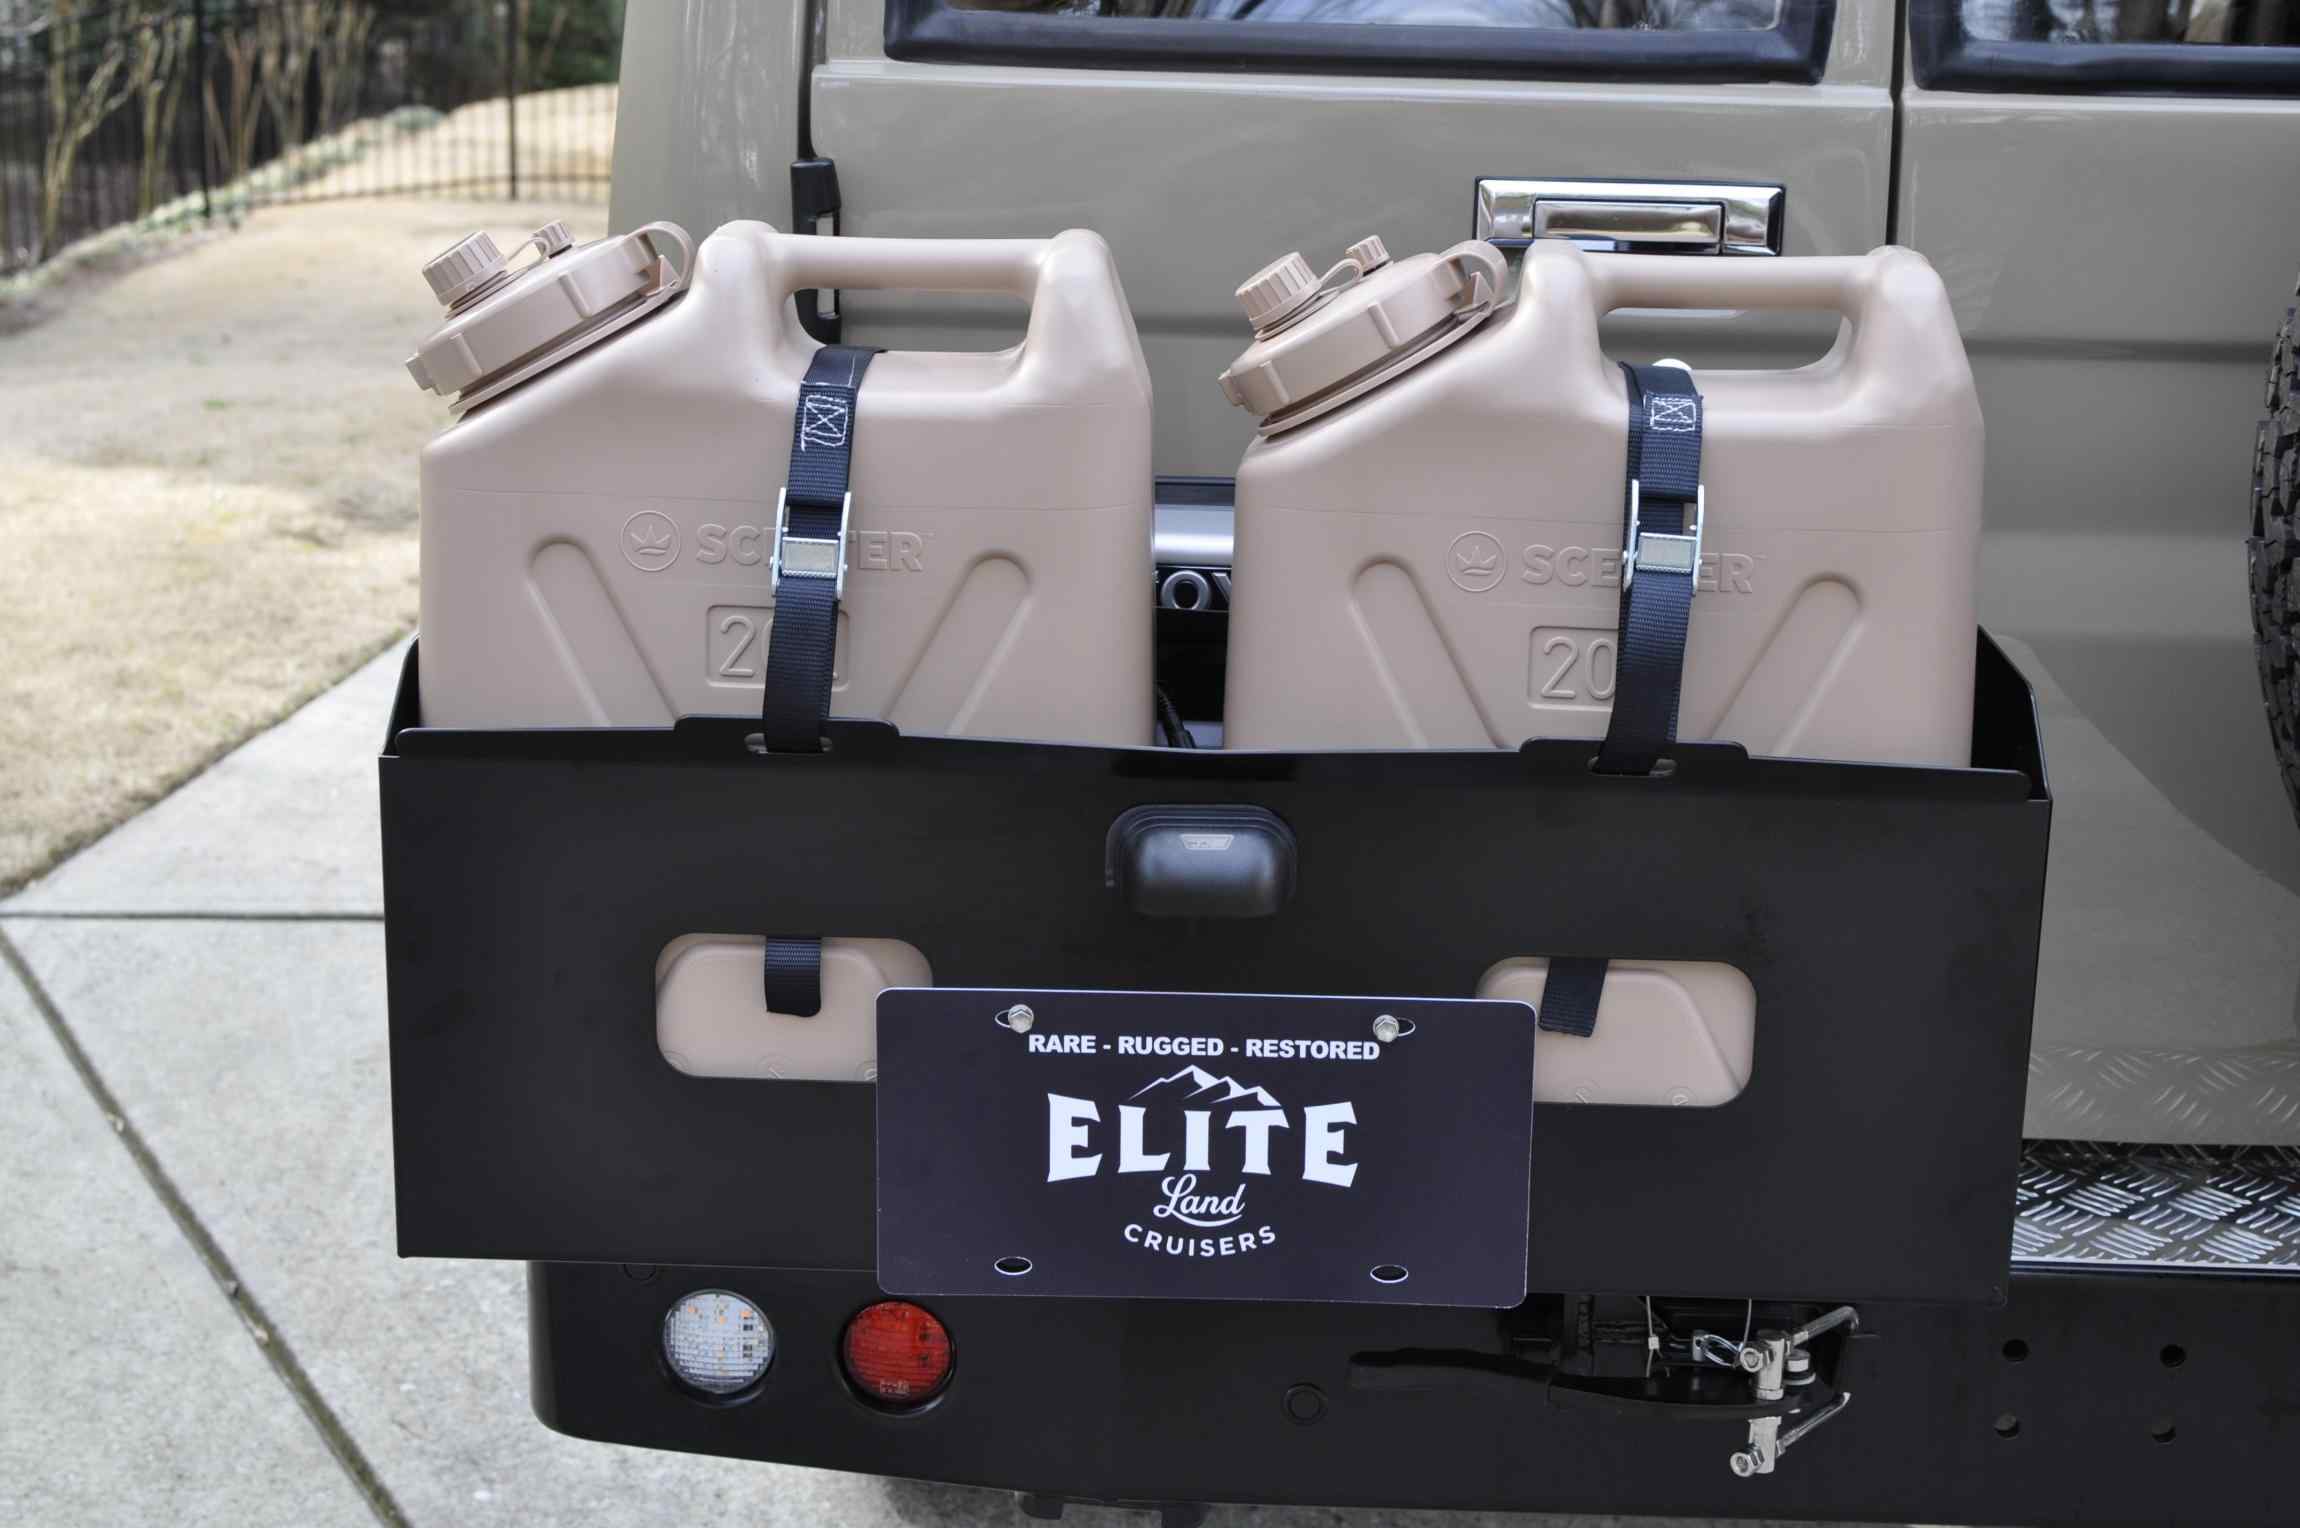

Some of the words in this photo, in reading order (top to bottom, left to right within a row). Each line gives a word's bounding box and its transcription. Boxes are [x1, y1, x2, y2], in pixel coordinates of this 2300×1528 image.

[1520, 543, 1754, 594] SCEER
[1028, 1034, 1097, 1054] RARE
[1118, 1035, 1225, 1058] RUGGED
[1245, 1038, 1381, 1060] RESTORED
[1047, 1092, 1359, 1188] ELITE
[1152, 1173, 1246, 1228] Land
[1123, 1223, 1276, 1257] CRUISERS
